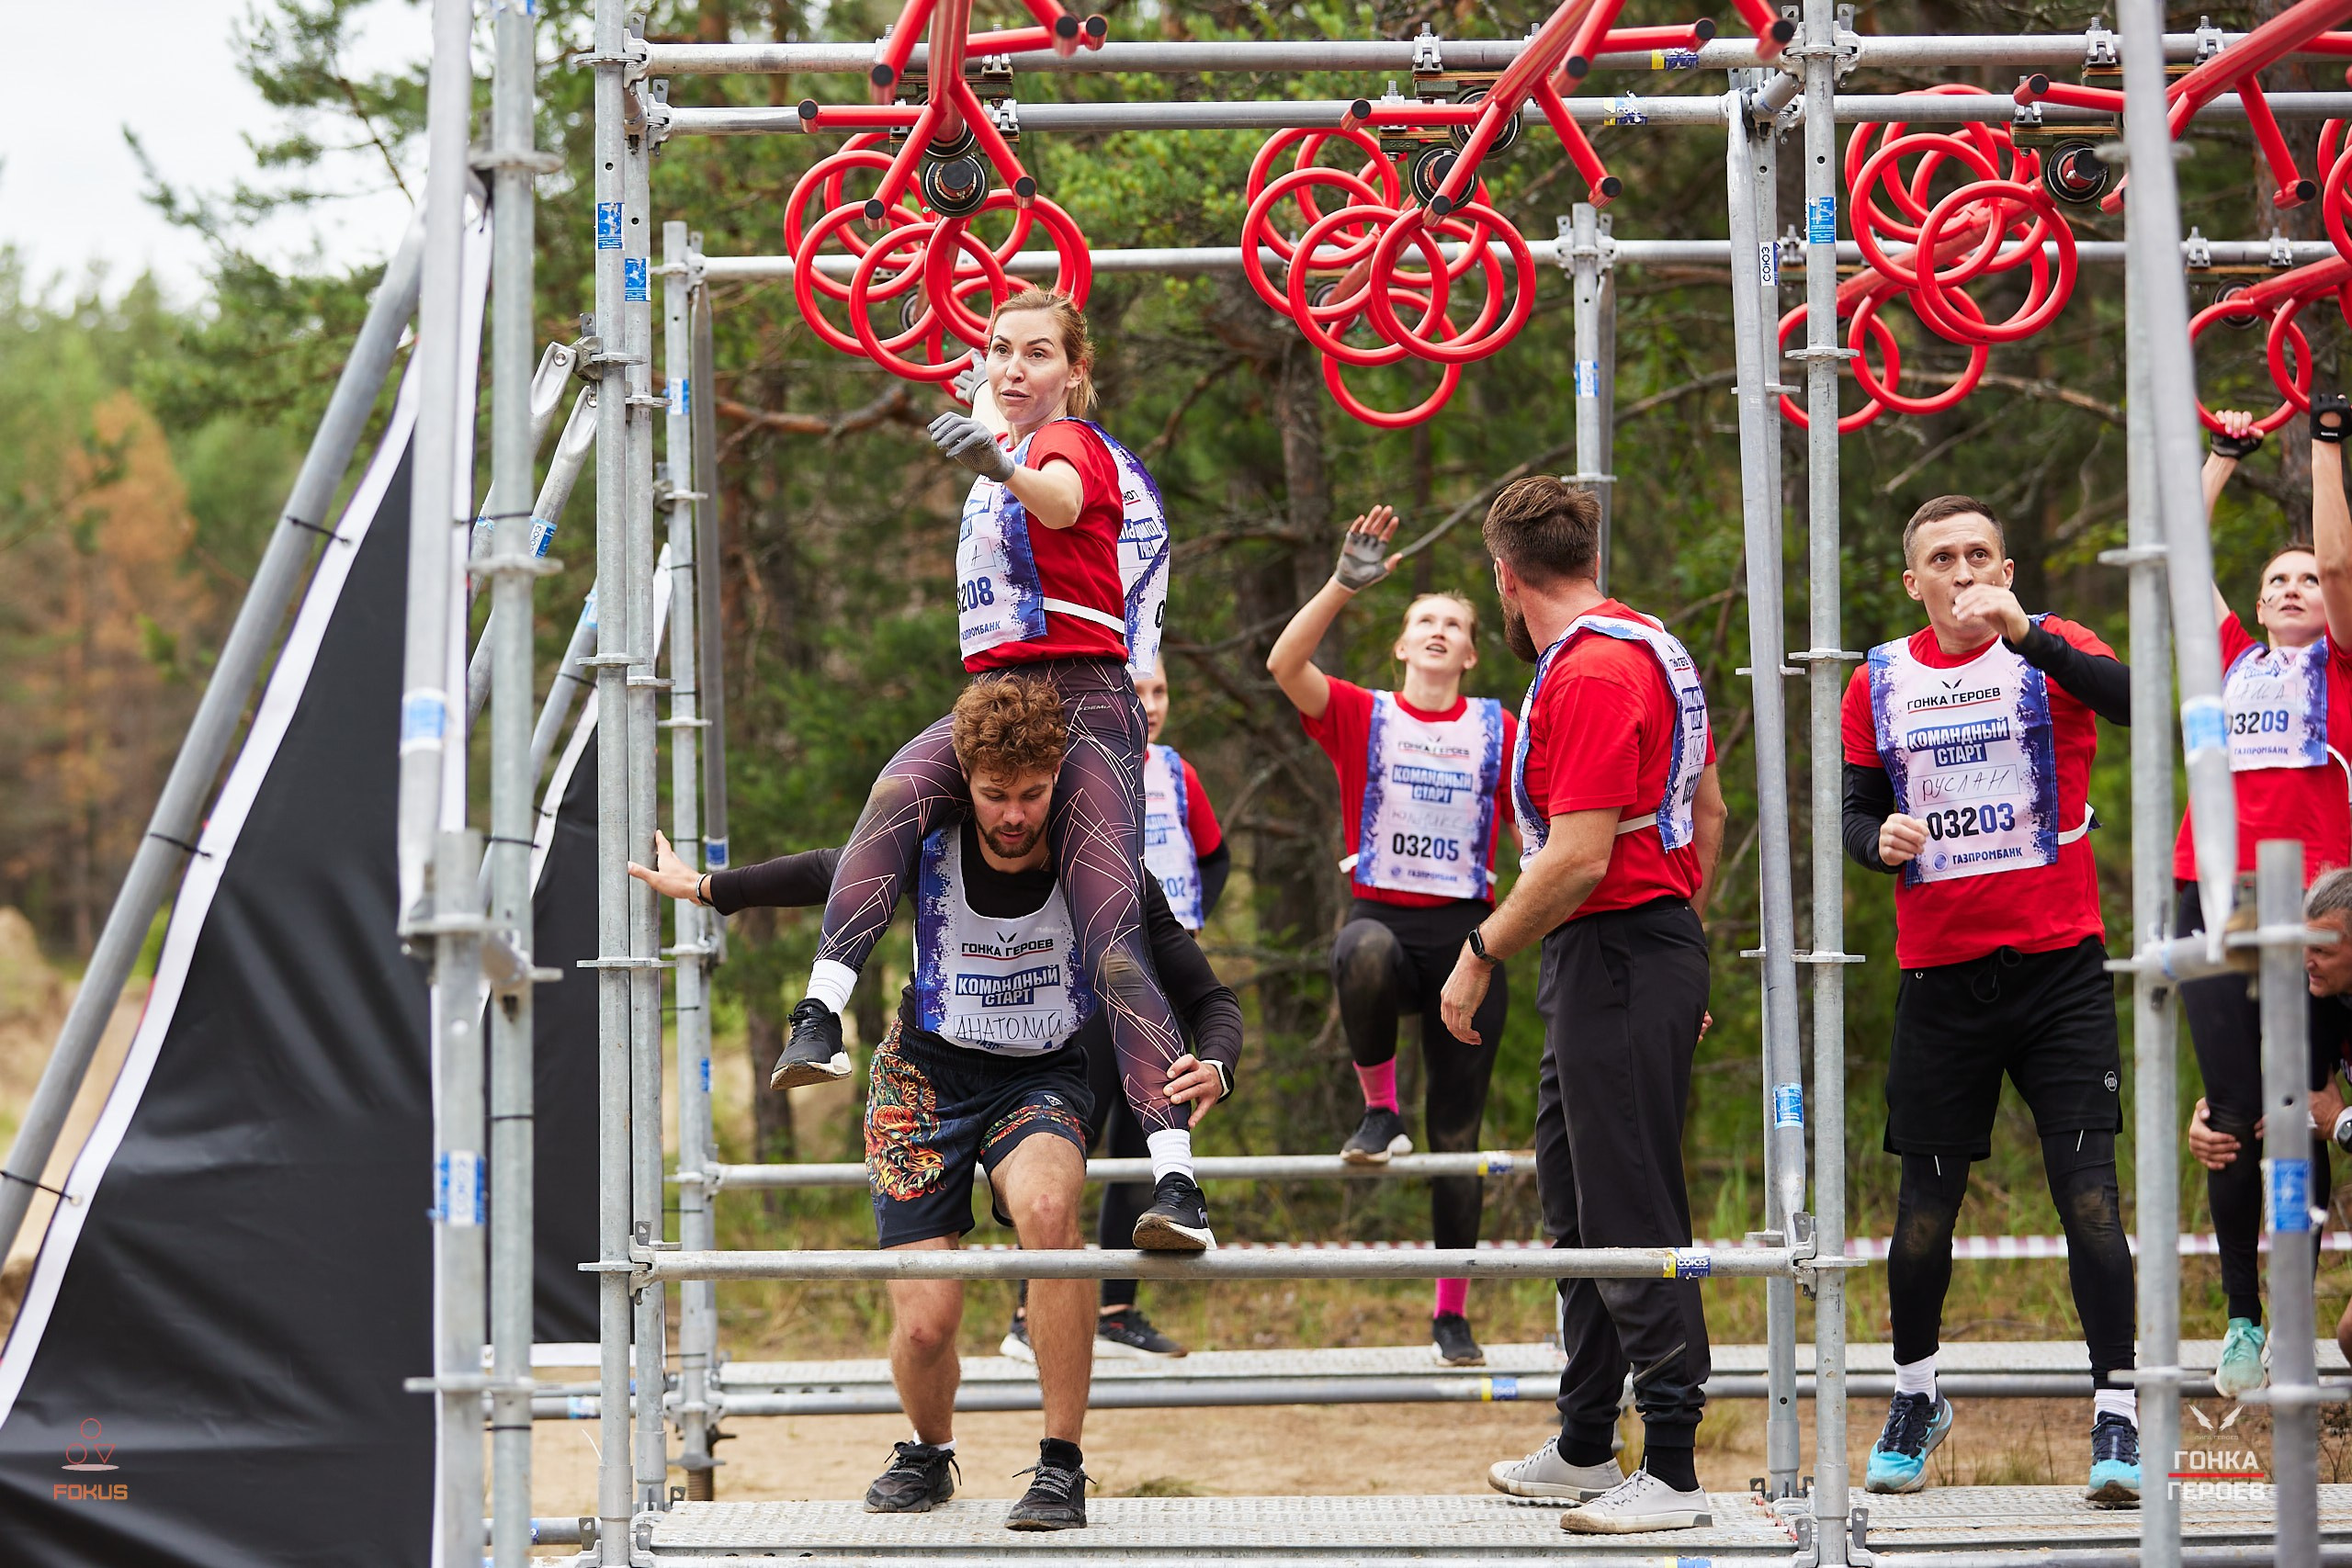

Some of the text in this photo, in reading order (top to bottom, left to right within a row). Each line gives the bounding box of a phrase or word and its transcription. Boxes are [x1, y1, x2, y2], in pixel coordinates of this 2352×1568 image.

[1761, 246, 1771, 282] СОЮЗ
[957, 576, 995, 616] 3208
[1906, 687, 2001, 711] ГОНКА ГЕРОЕВ
[1907, 716, 2009, 750] КОМАНДНЫЙ
[1937, 743, 1983, 765] СТАРТ
[1394, 765, 1472, 791] КОМАНДНЫЙ
[1922, 769, 2010, 802] РУСЛАН
[1413, 787, 1452, 803] СТАРТ
[1926, 803, 2016, 841] 03203
[1392, 833, 1459, 862] 03205
[1951, 847, 2023, 865] ГАЗПРОМБАНК
[961, 938, 1054, 957] ГОНКА ГЕРОЕВ
[956, 964, 1059, 995] КОМАНДНЫЙ
[984, 988, 1032, 1006] СТАРТ
